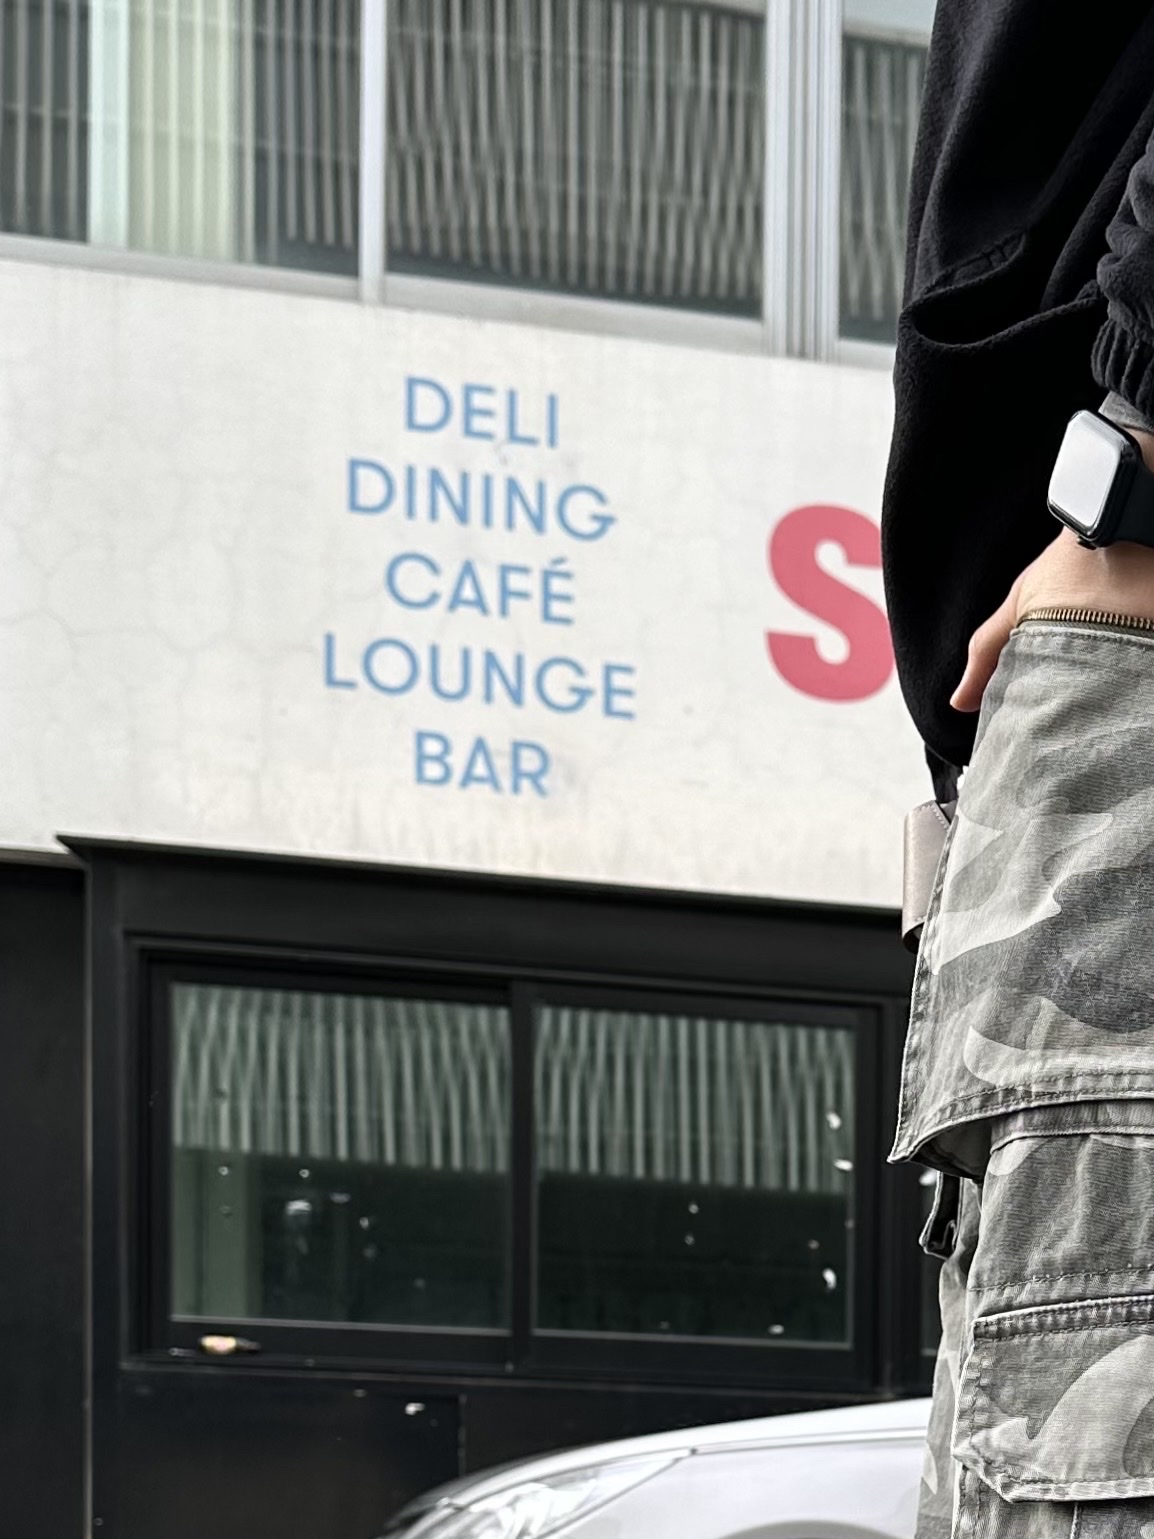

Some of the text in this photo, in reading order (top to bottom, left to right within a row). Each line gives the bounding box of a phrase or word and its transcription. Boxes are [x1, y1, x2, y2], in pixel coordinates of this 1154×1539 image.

[405, 375, 559, 449] DELI
[346, 457, 617, 542] DINING
[385, 551, 574, 626] CAFÉ
[324, 632, 636, 721] LOUNGE
[414, 729, 551, 797] BAR
